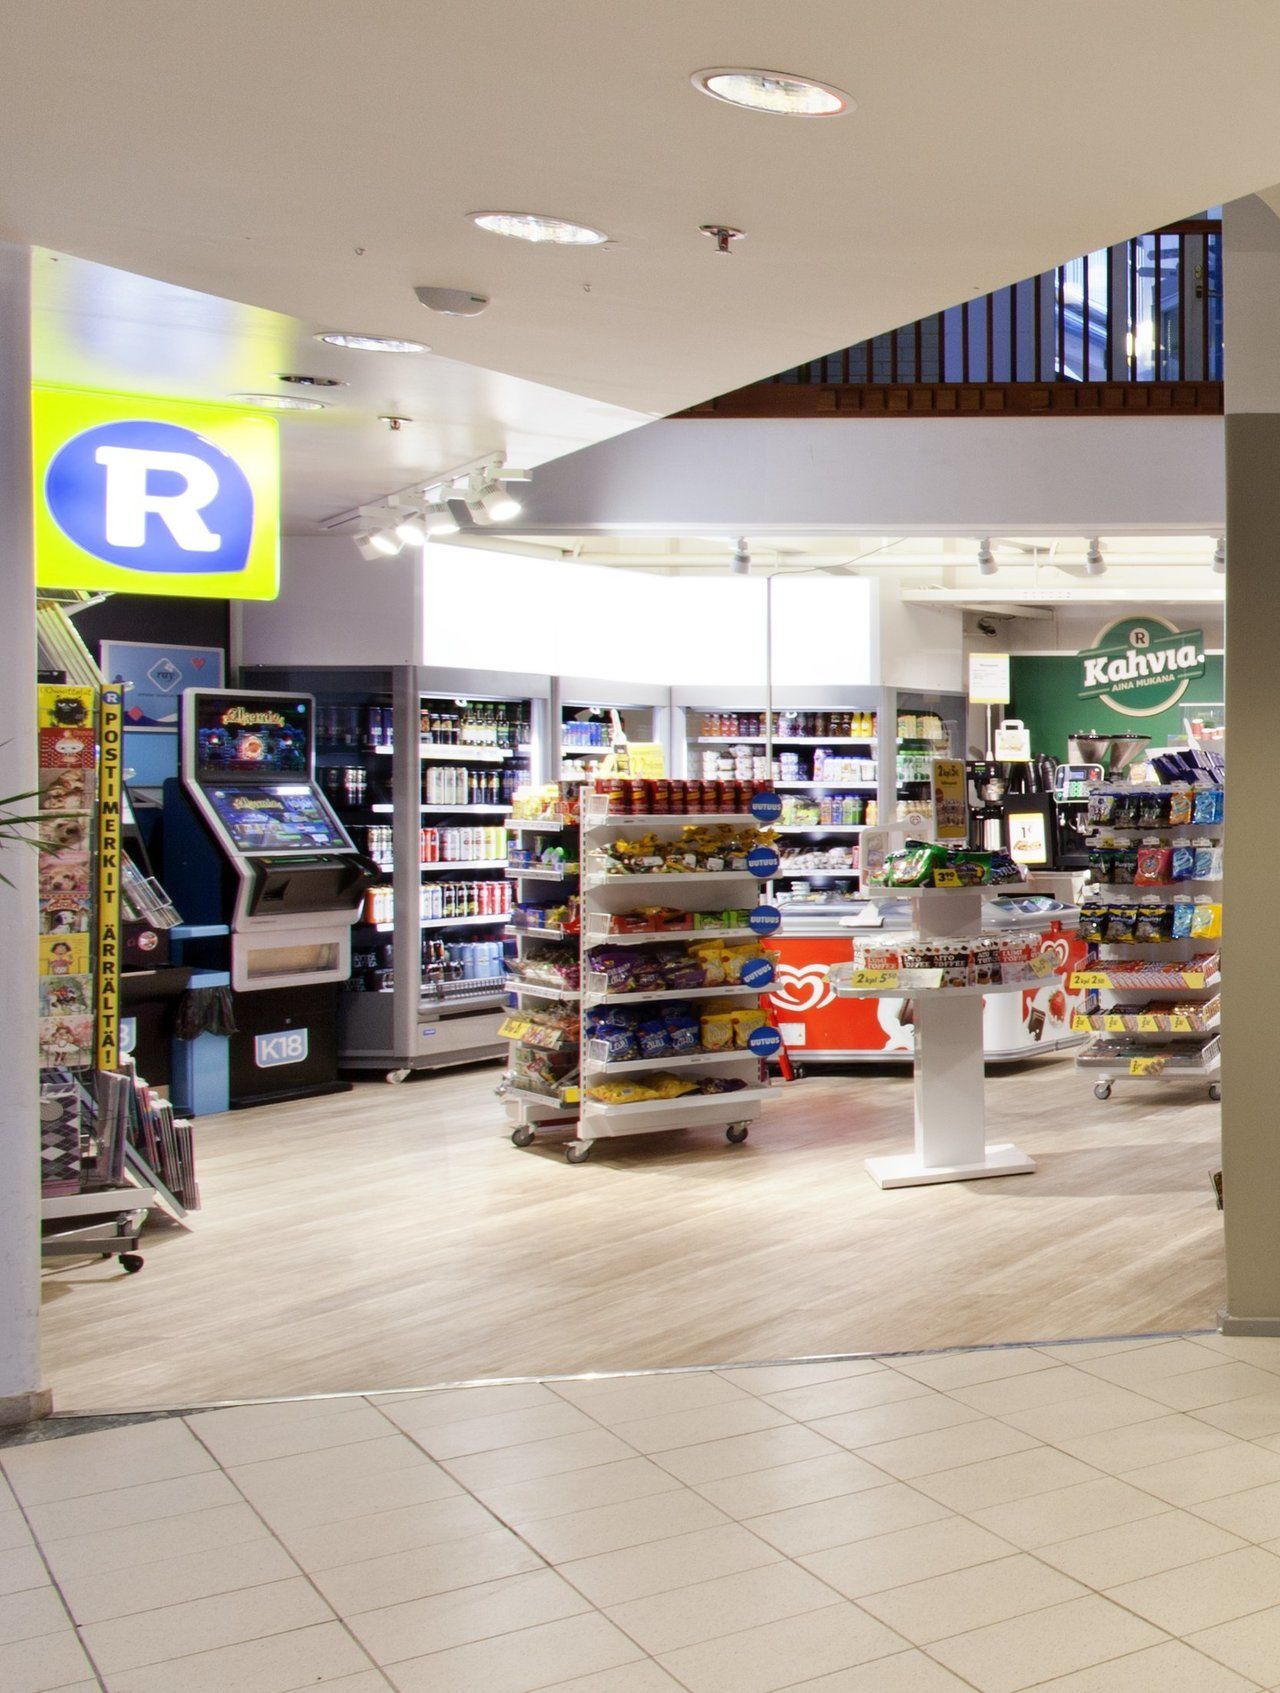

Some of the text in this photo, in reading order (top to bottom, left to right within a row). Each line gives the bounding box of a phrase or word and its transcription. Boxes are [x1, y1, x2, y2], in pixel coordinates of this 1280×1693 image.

[95, 446, 221, 552] R
[1135, 631, 1146, 644] R
[1111, 673, 1176, 692] AINA MUKANA
[106, 693, 118, 703] R
[752, 802, 781, 811] UUTUUS
[748, 858, 778, 867] UUTUUS
[101, 712, 119, 1063] POSTIMERKIT ÄRRÄLTÄ!
[750, 916, 780, 925] UUTUUS
[743, 963, 772, 983] UUTUUS
[857, 974, 865, 984] 2
[1074, 976, 1081, 984] 2
[750, 1036, 780, 1047] UUTUUS
[261, 1034, 303, 1062] K18
